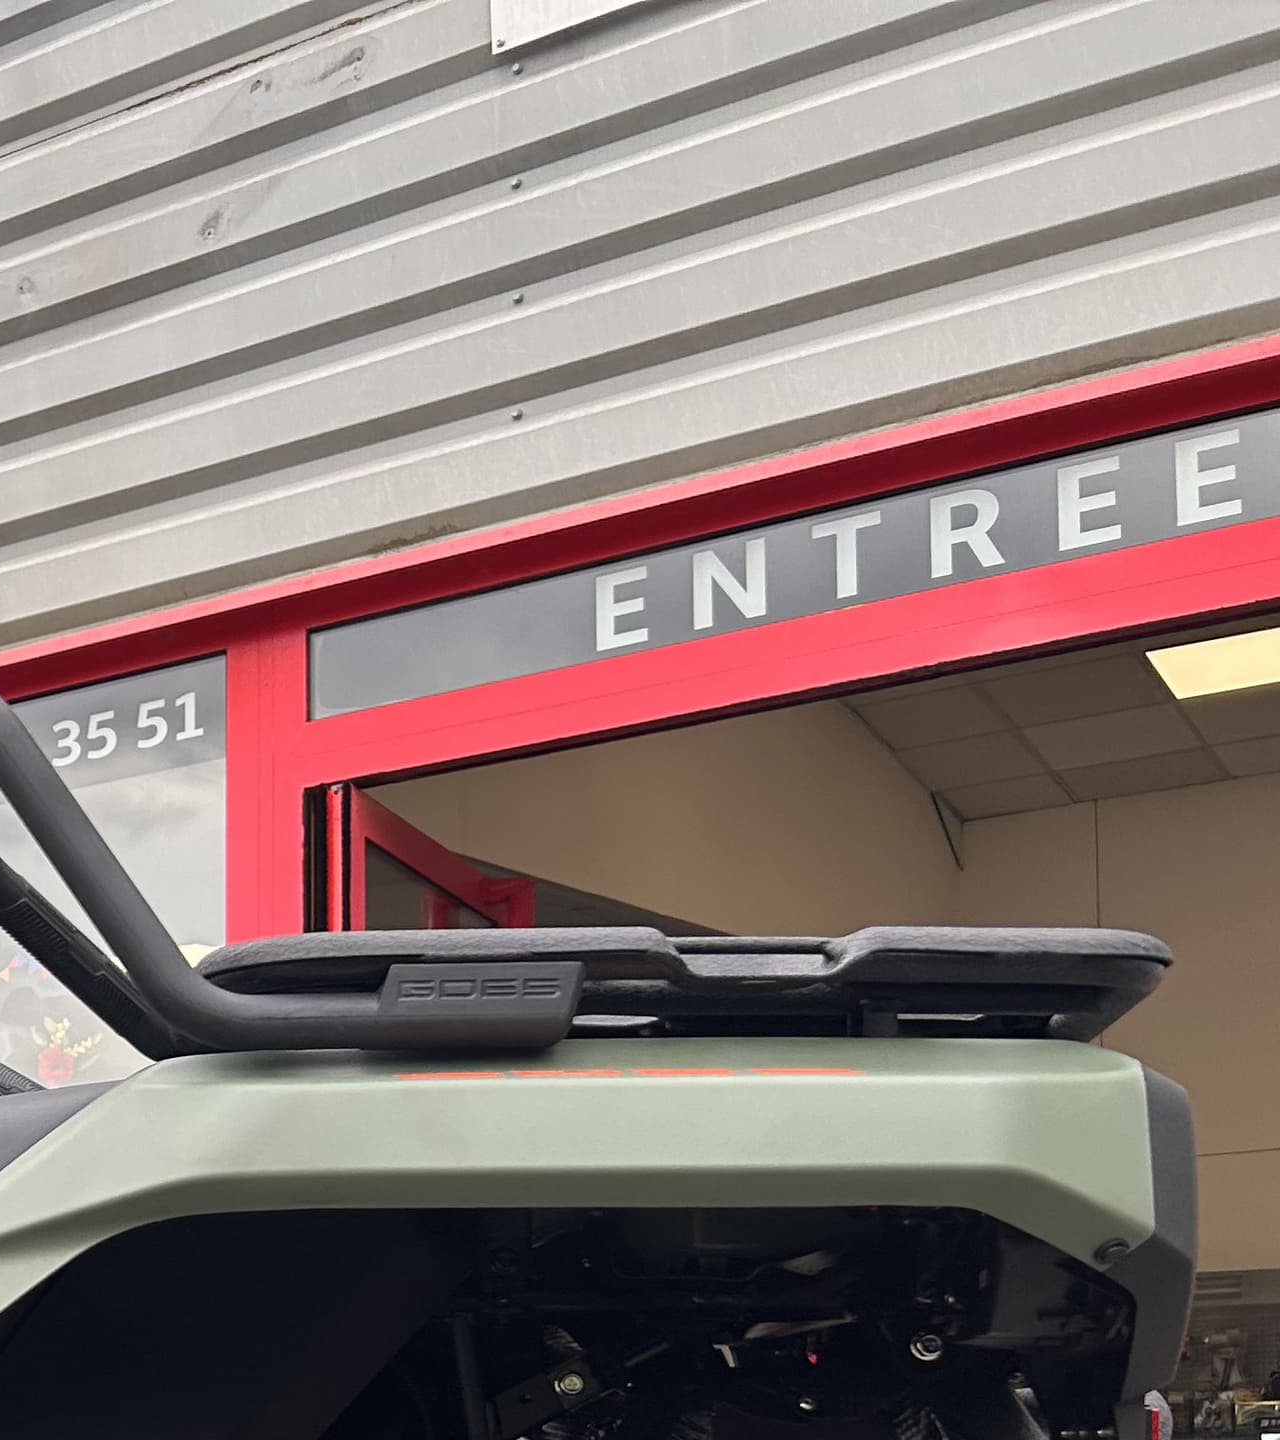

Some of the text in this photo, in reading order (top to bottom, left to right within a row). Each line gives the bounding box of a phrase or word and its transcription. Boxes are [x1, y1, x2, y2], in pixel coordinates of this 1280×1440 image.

[595, 428, 1243, 652] ENTREE
[51, 709, 118, 768] 35
[135, 691, 205, 749] 51
[397, 978, 561, 1001] GOES
